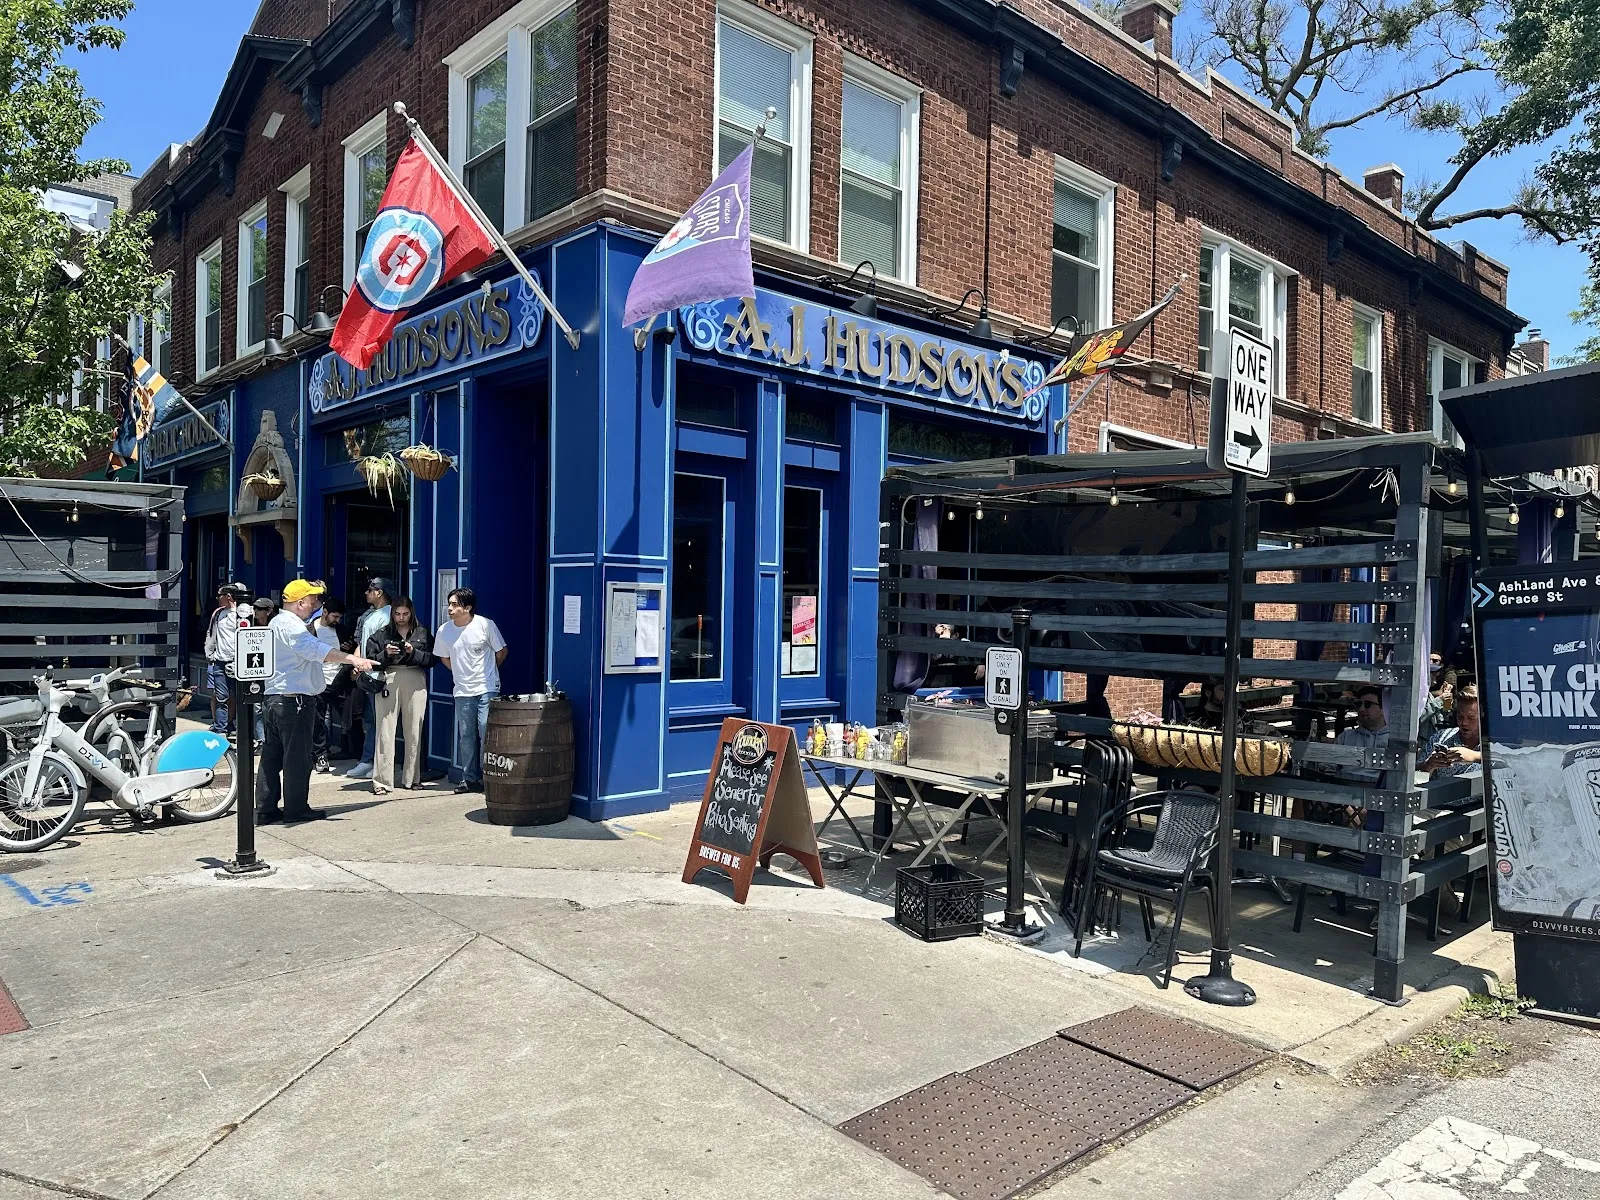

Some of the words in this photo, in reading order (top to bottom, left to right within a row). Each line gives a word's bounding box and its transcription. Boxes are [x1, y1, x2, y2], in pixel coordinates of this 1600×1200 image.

[690, 195, 720, 239] STARS
[1236, 344, 1267, 385] ONE
[1234, 380, 1267, 420] WAY
[148, 423, 180, 460] PUBLIC
[181, 410, 218, 453] HOUSE
[1498, 579, 1554, 593] Ashland
[1561, 576, 1588, 589] Ave
[1499, 593, 1539, 606] Grace
[1546, 590, 1564, 603] St
[994, 653, 1013, 661] CROSS
[996, 660, 1011, 669] ONLY
[1498, 664, 1556, 691] HEY
[992, 695, 1012, 703] SIGNAL
[1500, 691, 1598, 718] DRINK
[79, 746, 108, 770] DIVVY
[720, 758, 750, 781] Please
[750, 768, 768, 788] See
[699, 845, 721, 862] BREWED
[720, 852, 731, 867] FOR
